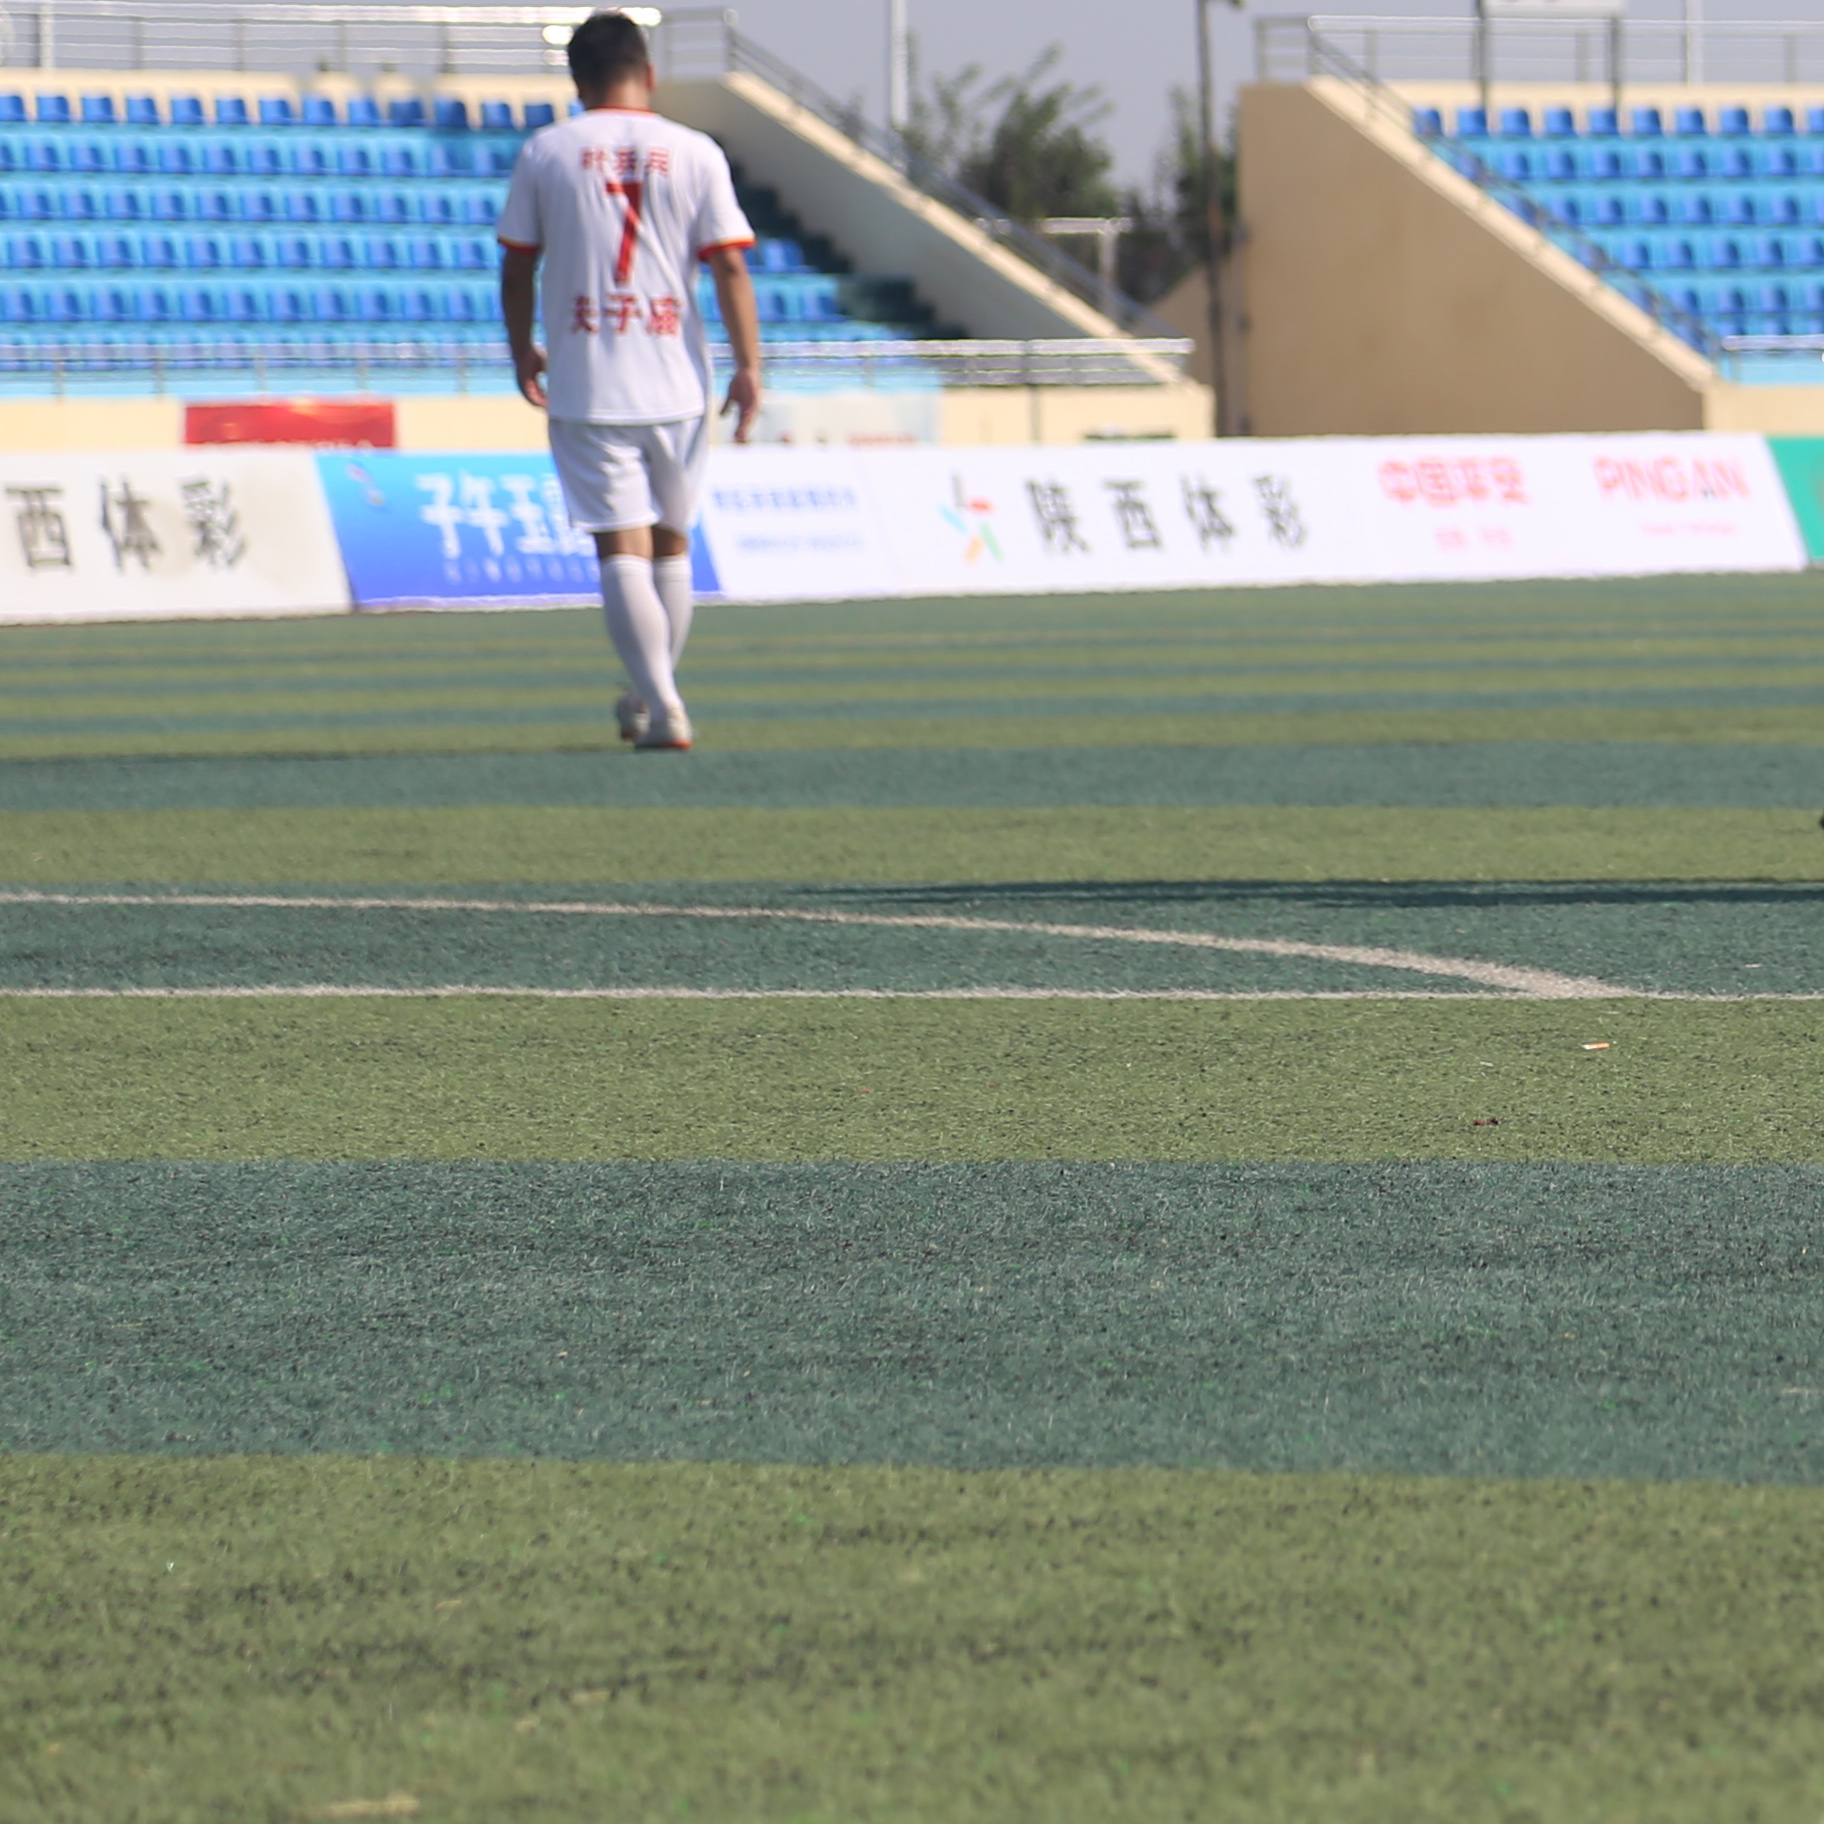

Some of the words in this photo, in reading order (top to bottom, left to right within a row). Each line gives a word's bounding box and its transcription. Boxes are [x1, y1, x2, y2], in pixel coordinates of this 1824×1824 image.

[606, 182, 643, 286] 7
[6, 475, 246, 570] 西体彩
[1025, 475, 1307, 554] 陕西体彩
